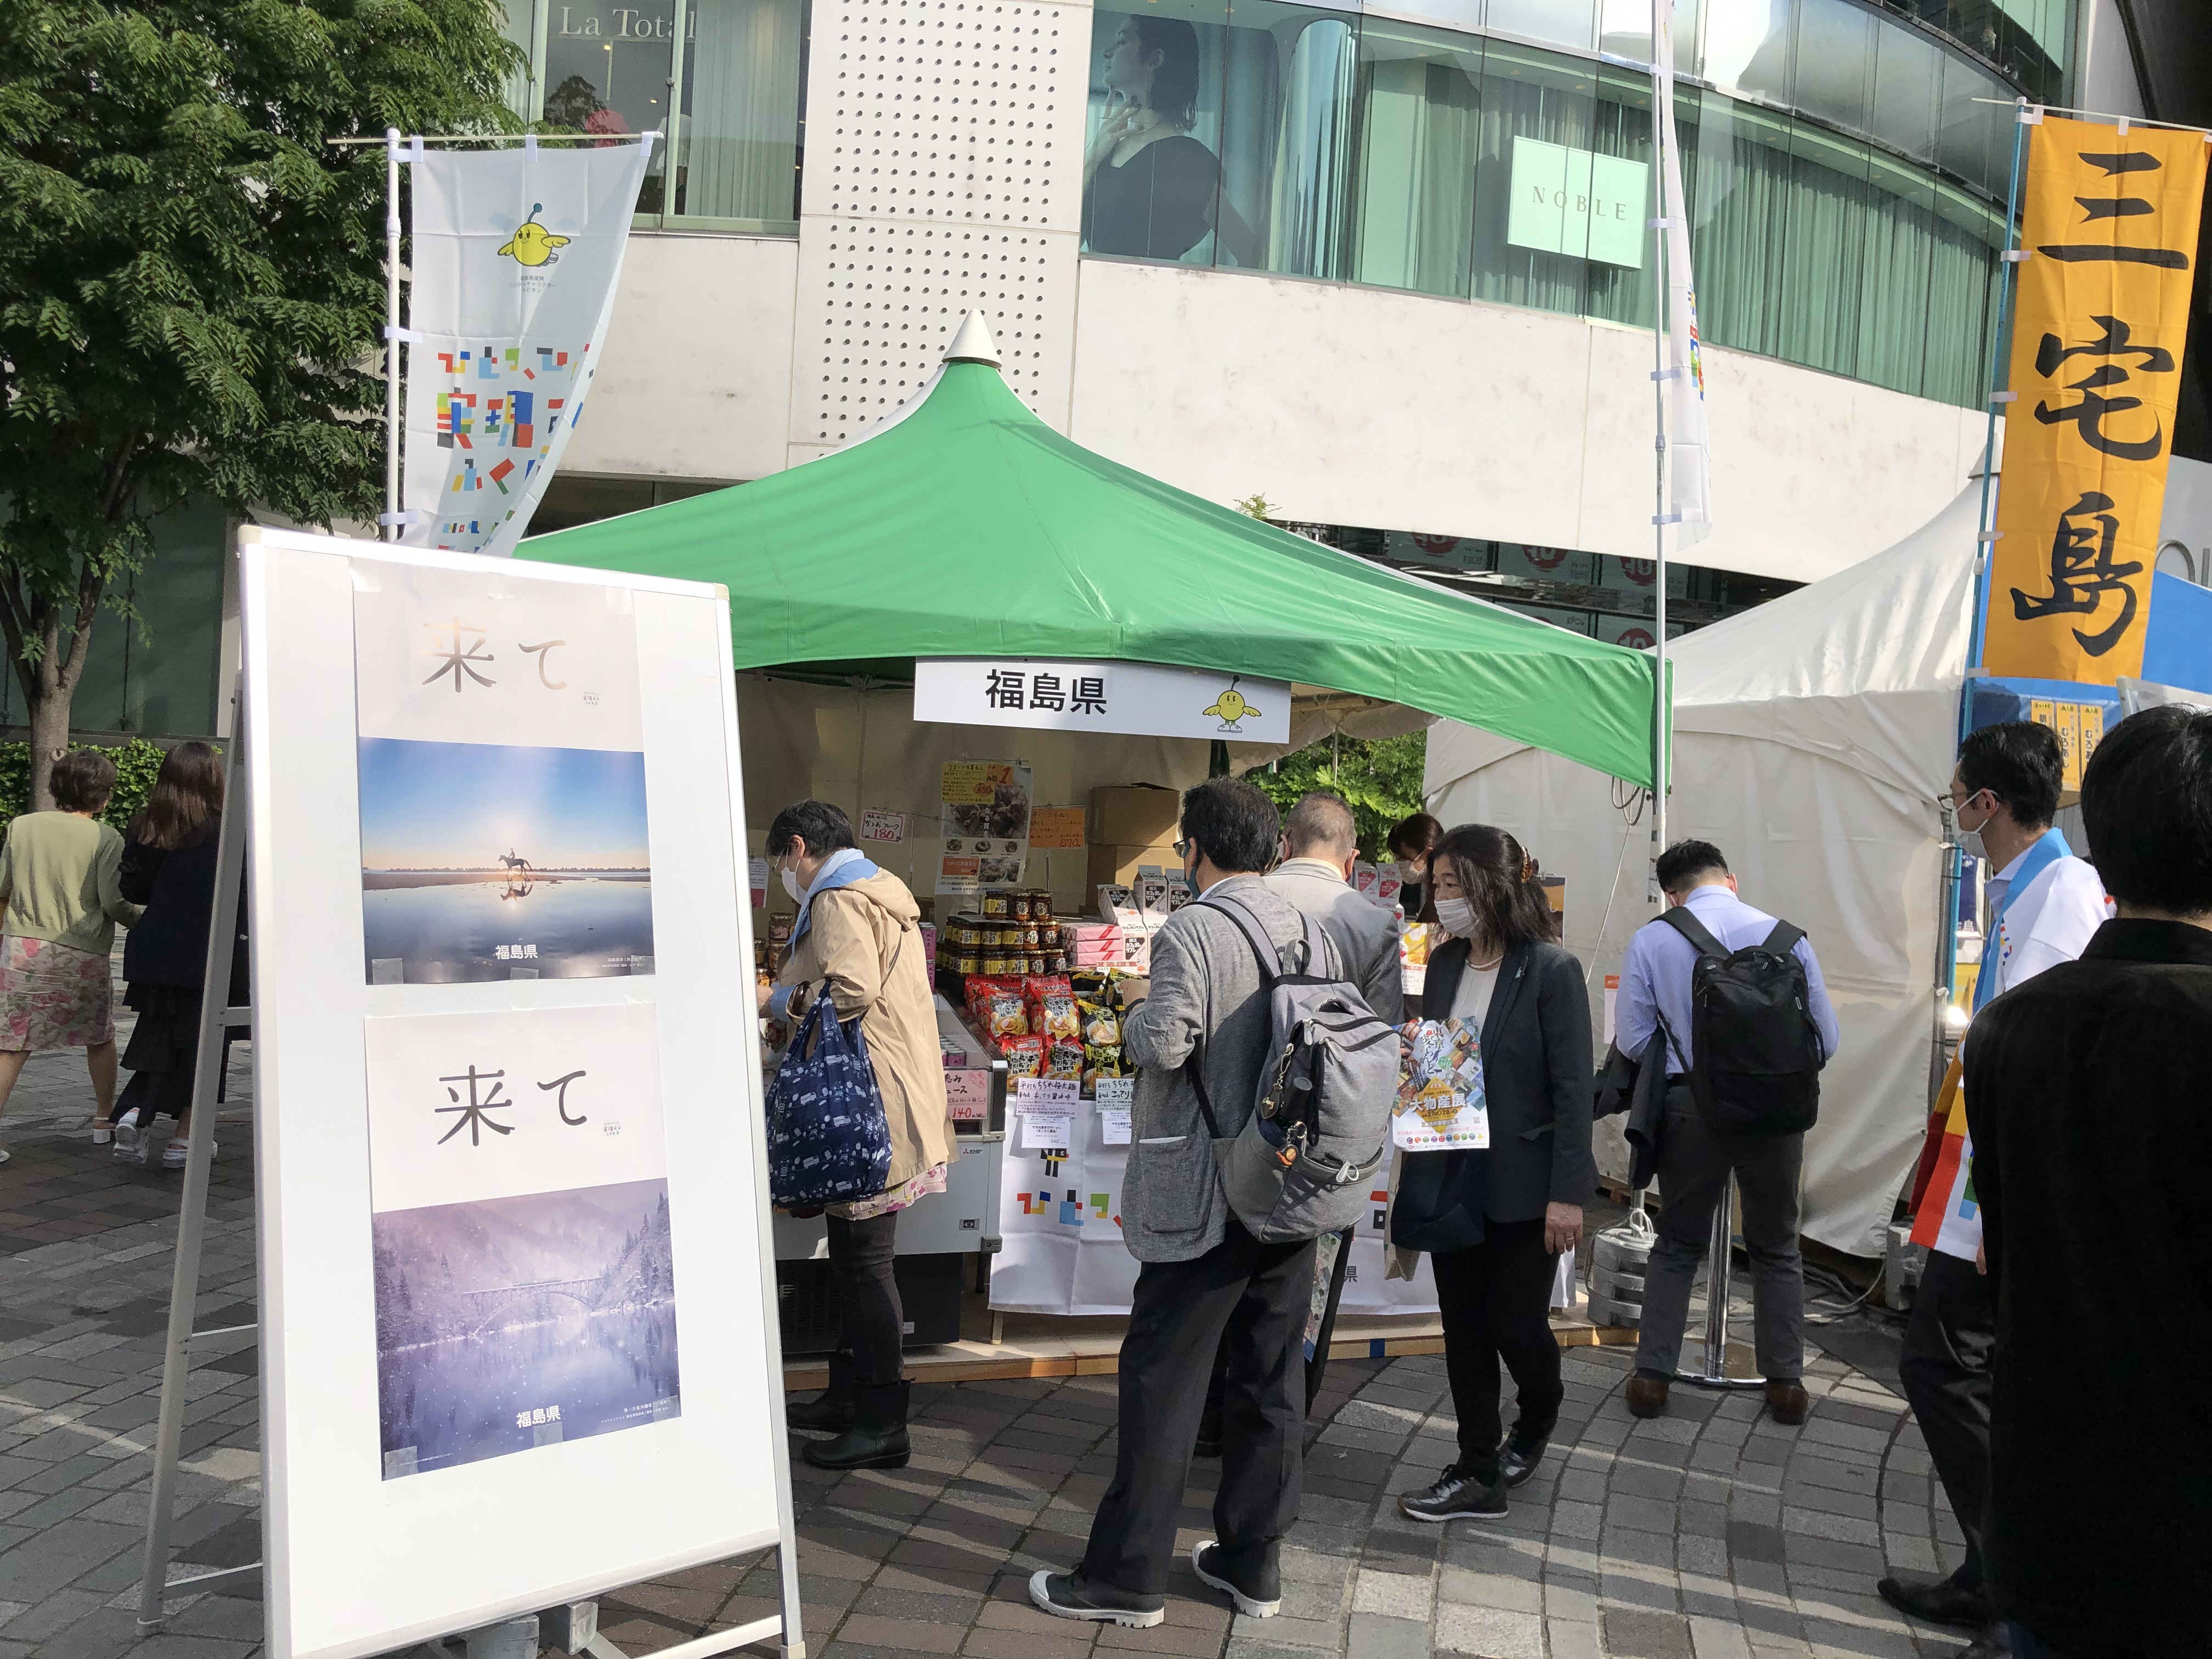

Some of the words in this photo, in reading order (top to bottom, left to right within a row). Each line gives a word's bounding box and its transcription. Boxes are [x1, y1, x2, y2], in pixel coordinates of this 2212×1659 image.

[559, 7, 602, 35] La
[612, 9, 695, 38] Totl
[1533, 186, 1627, 221] NOBLE
[2010, 151, 2189, 657] 三宅島
[421, 616, 567, 693] 来て
[985, 669, 1108, 715] 福島県
[494, 944, 538, 960] 福島県
[435, 1064, 587, 1147] 来て
[1409, 1093, 1466, 1113] 大物産展
[516, 1404, 561, 1429] 福島県
